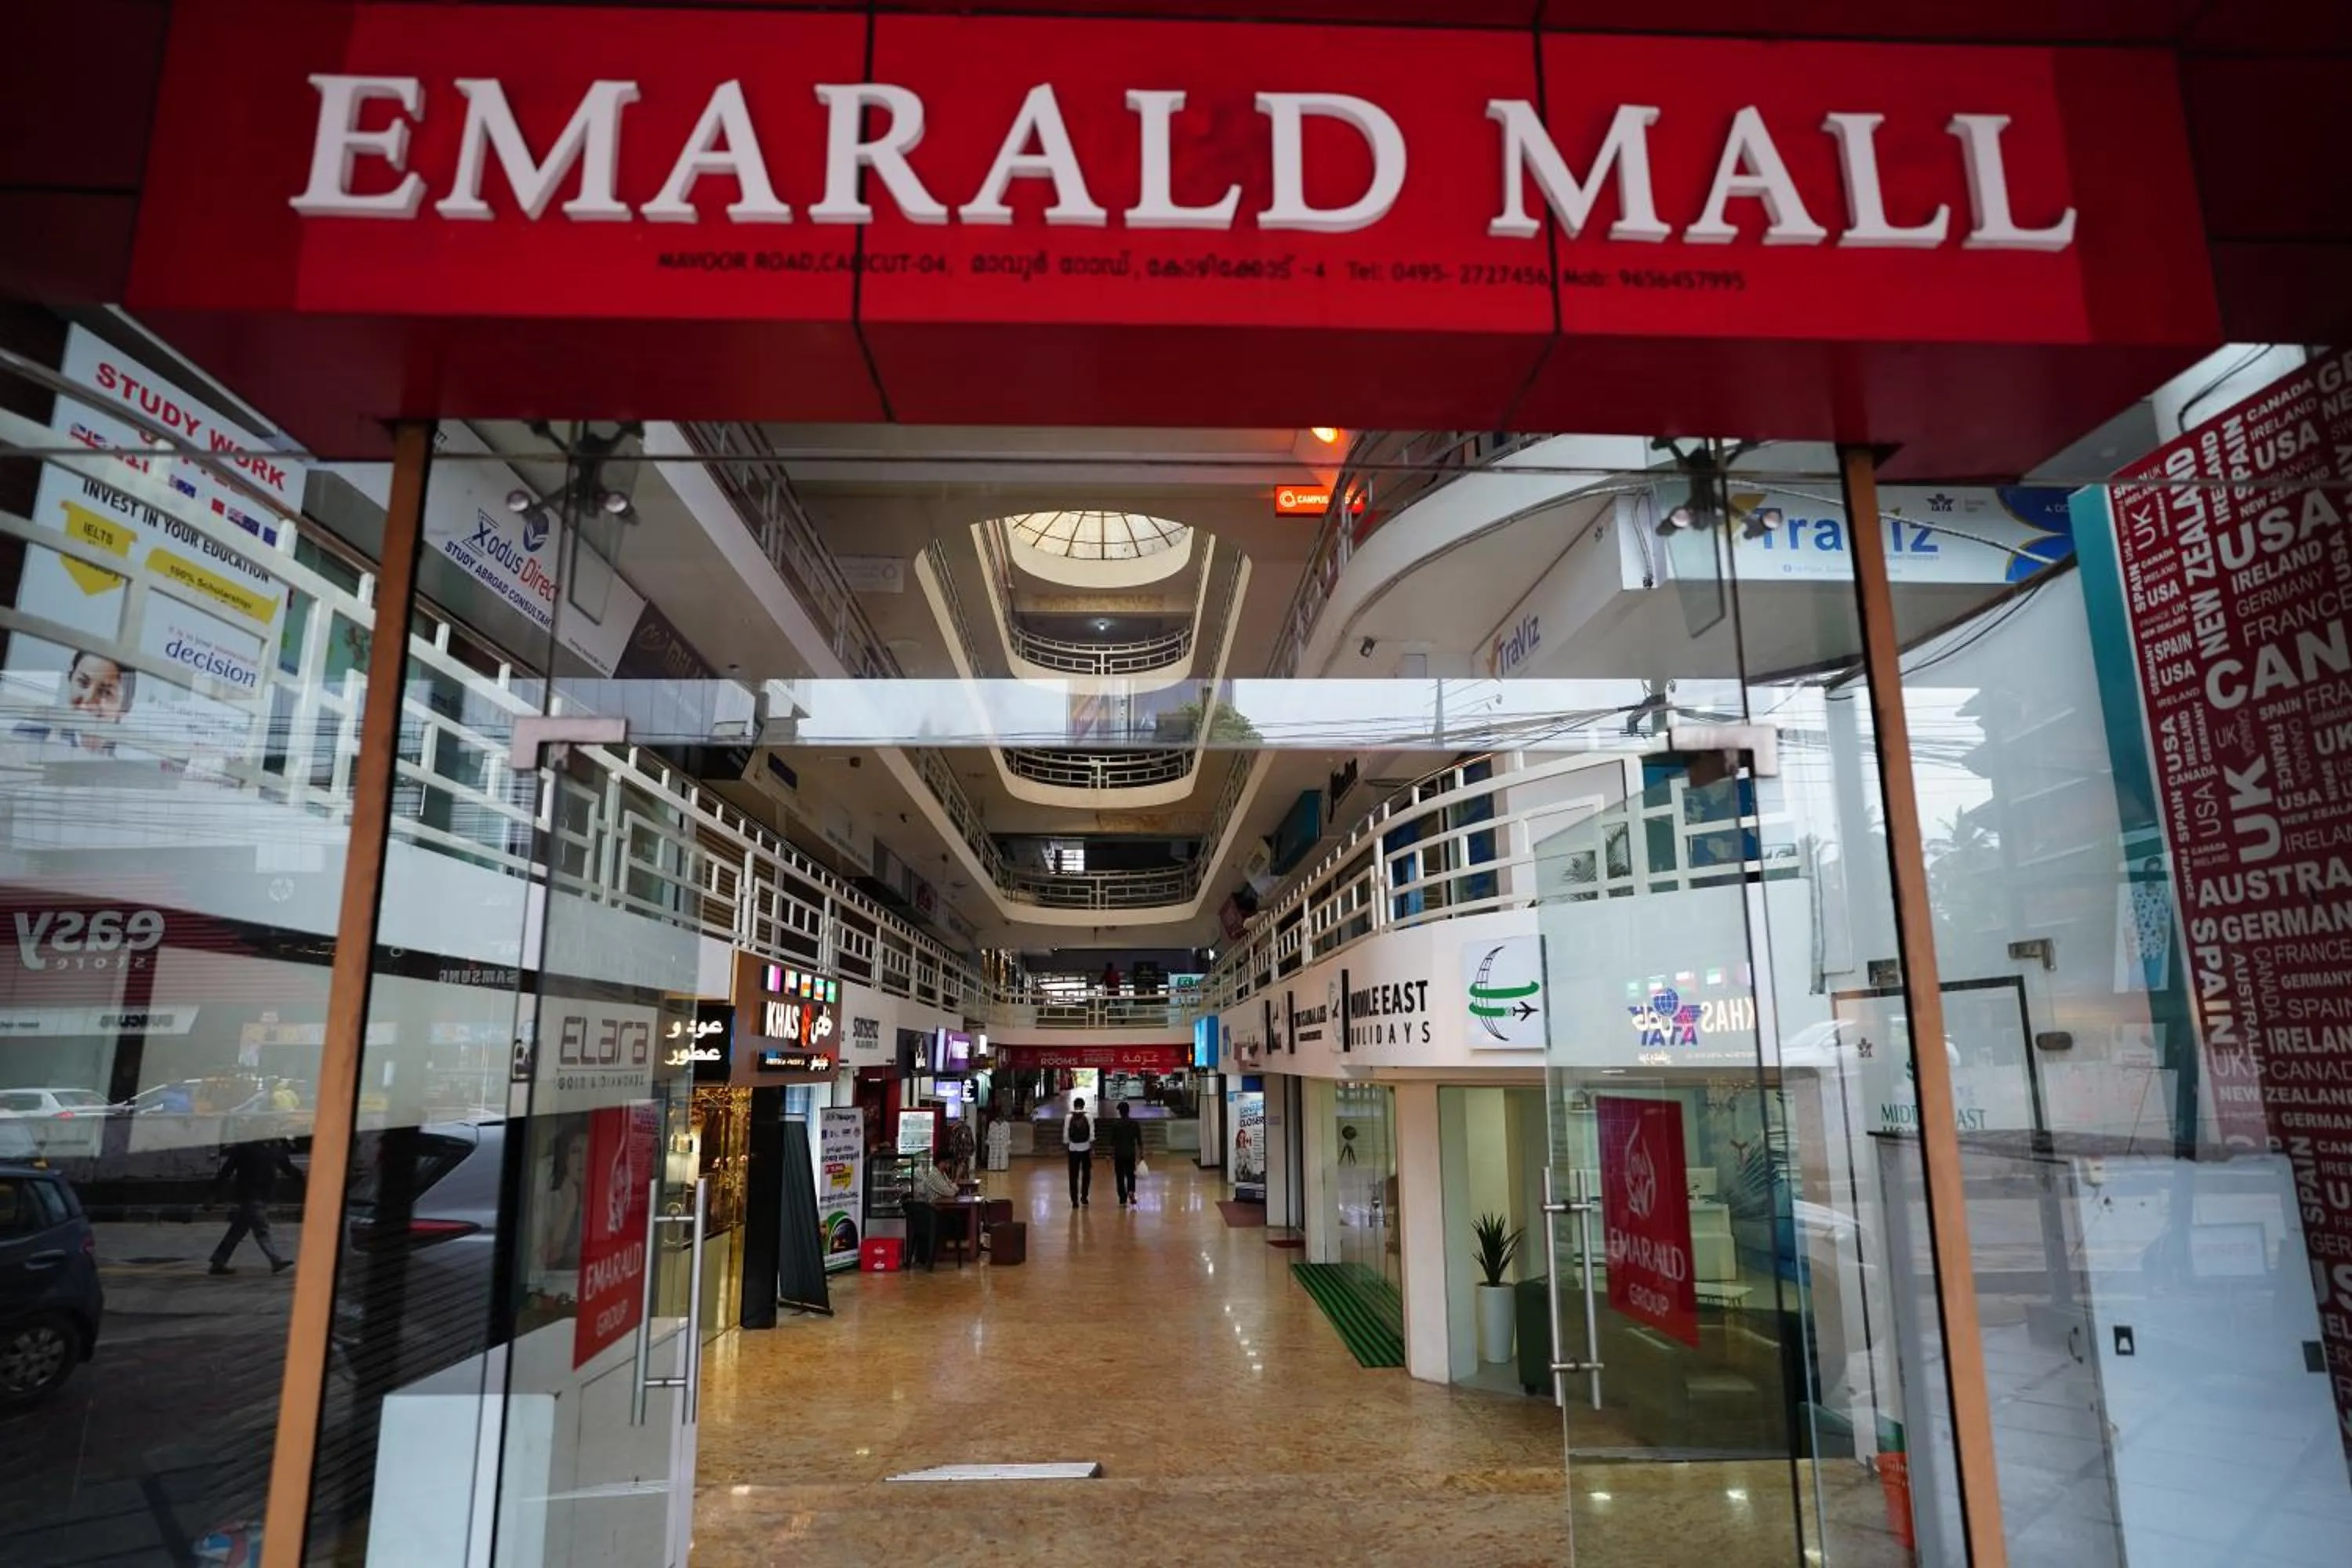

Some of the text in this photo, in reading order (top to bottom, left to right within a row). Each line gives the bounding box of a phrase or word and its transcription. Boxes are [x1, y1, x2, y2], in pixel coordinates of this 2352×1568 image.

[289, 74, 2077, 252] EMARALD MALL
[2246, 377, 2315, 423] CANADA
[2249, 397, 2318, 444] IRELAND
[96, 361, 201, 437] STUDY
[209, 428, 287, 492] WORK
[2254, 419, 2321, 471] USA
[82, 477, 140, 518] INVEST
[142, 506, 158, 528] IN
[162, 515, 199, 550] YOUR
[1755, 507, 1940, 553] Traiz
[2131, 503, 2156, 550] UK
[2217, 488, 2342, 571] USA
[2239, 495, 2268, 518] NEW
[82, 521, 114, 546] IELTS
[2141, 546, 2176, 569] CANADA
[2165, 446, 2230, 660] NEW ZEALAND
[2329, 528, 2352, 583] USA
[445, 540, 554, 629] STUDY ABROAD CONSULTAN
[2127, 561, 2147, 614] SPAIN
[2230, 539, 2323, 595] IRELAND
[2236, 566, 2325, 618] GERMANY
[2146, 579, 2181, 608] USA
[2171, 601, 2189, 615] UK
[2242, 583, 2352, 648] FRANCE
[165, 638, 257, 688] decision
[2154, 630, 2194, 662] SPAIN
[2157, 687, 2201, 709] IRELAND
[2160, 659, 2197, 687] USA
[2259, 695, 2302, 721] SPAIN
[2160, 714, 2183, 773] USA
[2179, 710, 2198, 767] IRELAND
[2215, 722, 2239, 750] UK
[2267, 722, 2295, 792] FRANCE
[2167, 764, 2219, 787] CANADA
[2276, 787, 2323, 811] USA
[2169, 789, 2190, 844] SPAIN
[2192, 781, 2222, 839] USA
[2222, 753, 2281, 864] UK
[1381, 979, 1428, 1015] EAST
[2190, 916, 2239, 1045] SPAIN
[2252, 946, 2283, 1021] CANADA
[764, 1000, 800, 1040] KHAS
[2231, 952, 2267, 1078] AUSTRALIA
[664, 1042, 722, 1065] عطور
[1040, 1057, 1079, 1065] ROOMS
[2211, 1044, 2249, 1078] UK
[2217, 1085, 2261, 1104] NEW
[2288, 1135, 2327, 1225] SPAIN
[584, 1242, 644, 1301] EMARALD
[1610, 1227, 1686, 1282] EMARALD
[596, 1300, 627, 1338] GROUP
[1628, 1283, 1669, 1318] GROUP
